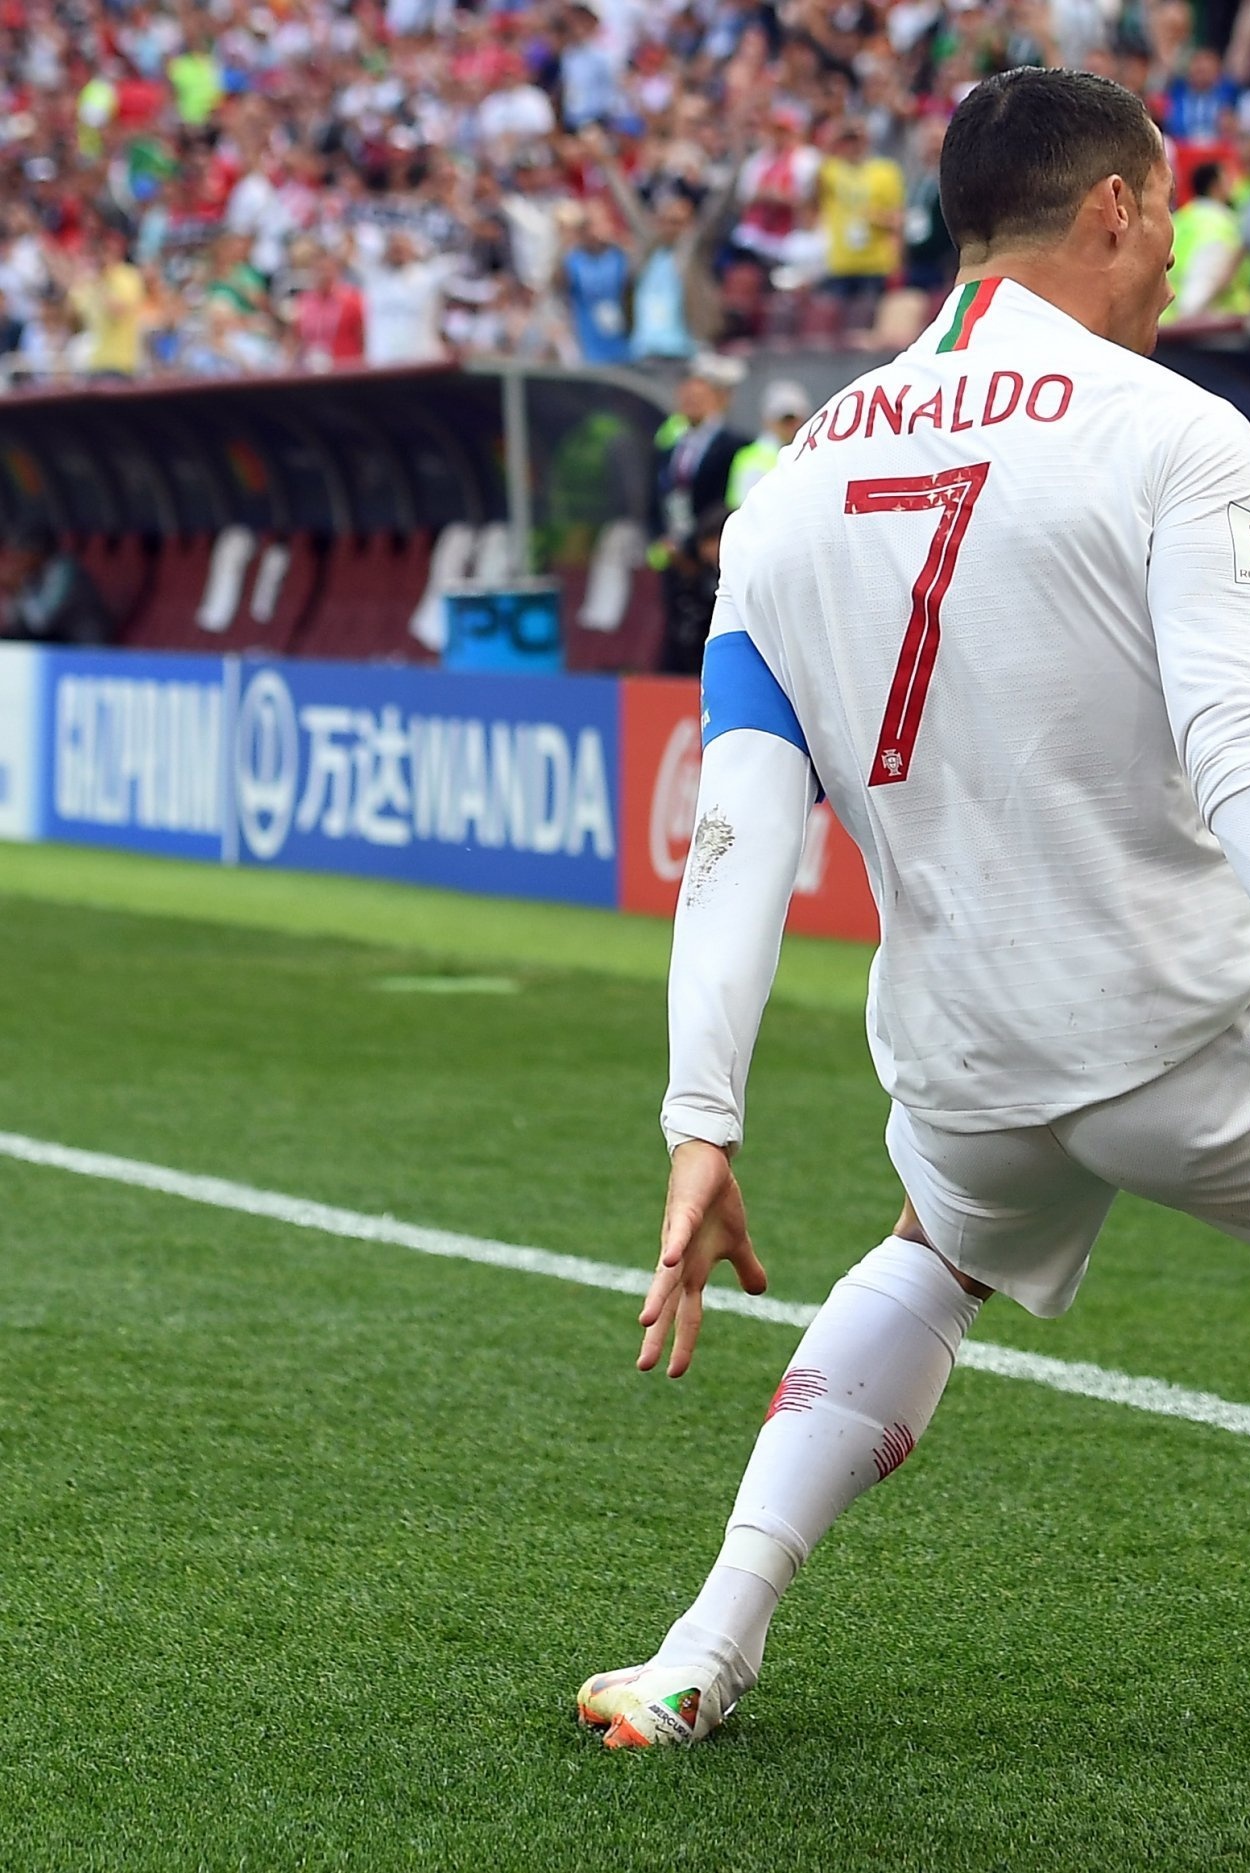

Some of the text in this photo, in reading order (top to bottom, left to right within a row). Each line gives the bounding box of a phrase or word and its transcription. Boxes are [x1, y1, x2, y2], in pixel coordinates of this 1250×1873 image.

[793, 370, 1074, 462] RONALDO
[843, 461, 991, 788] 7
[300, 704, 413, 846] 万达
[413, 715, 614, 859] WANDA
